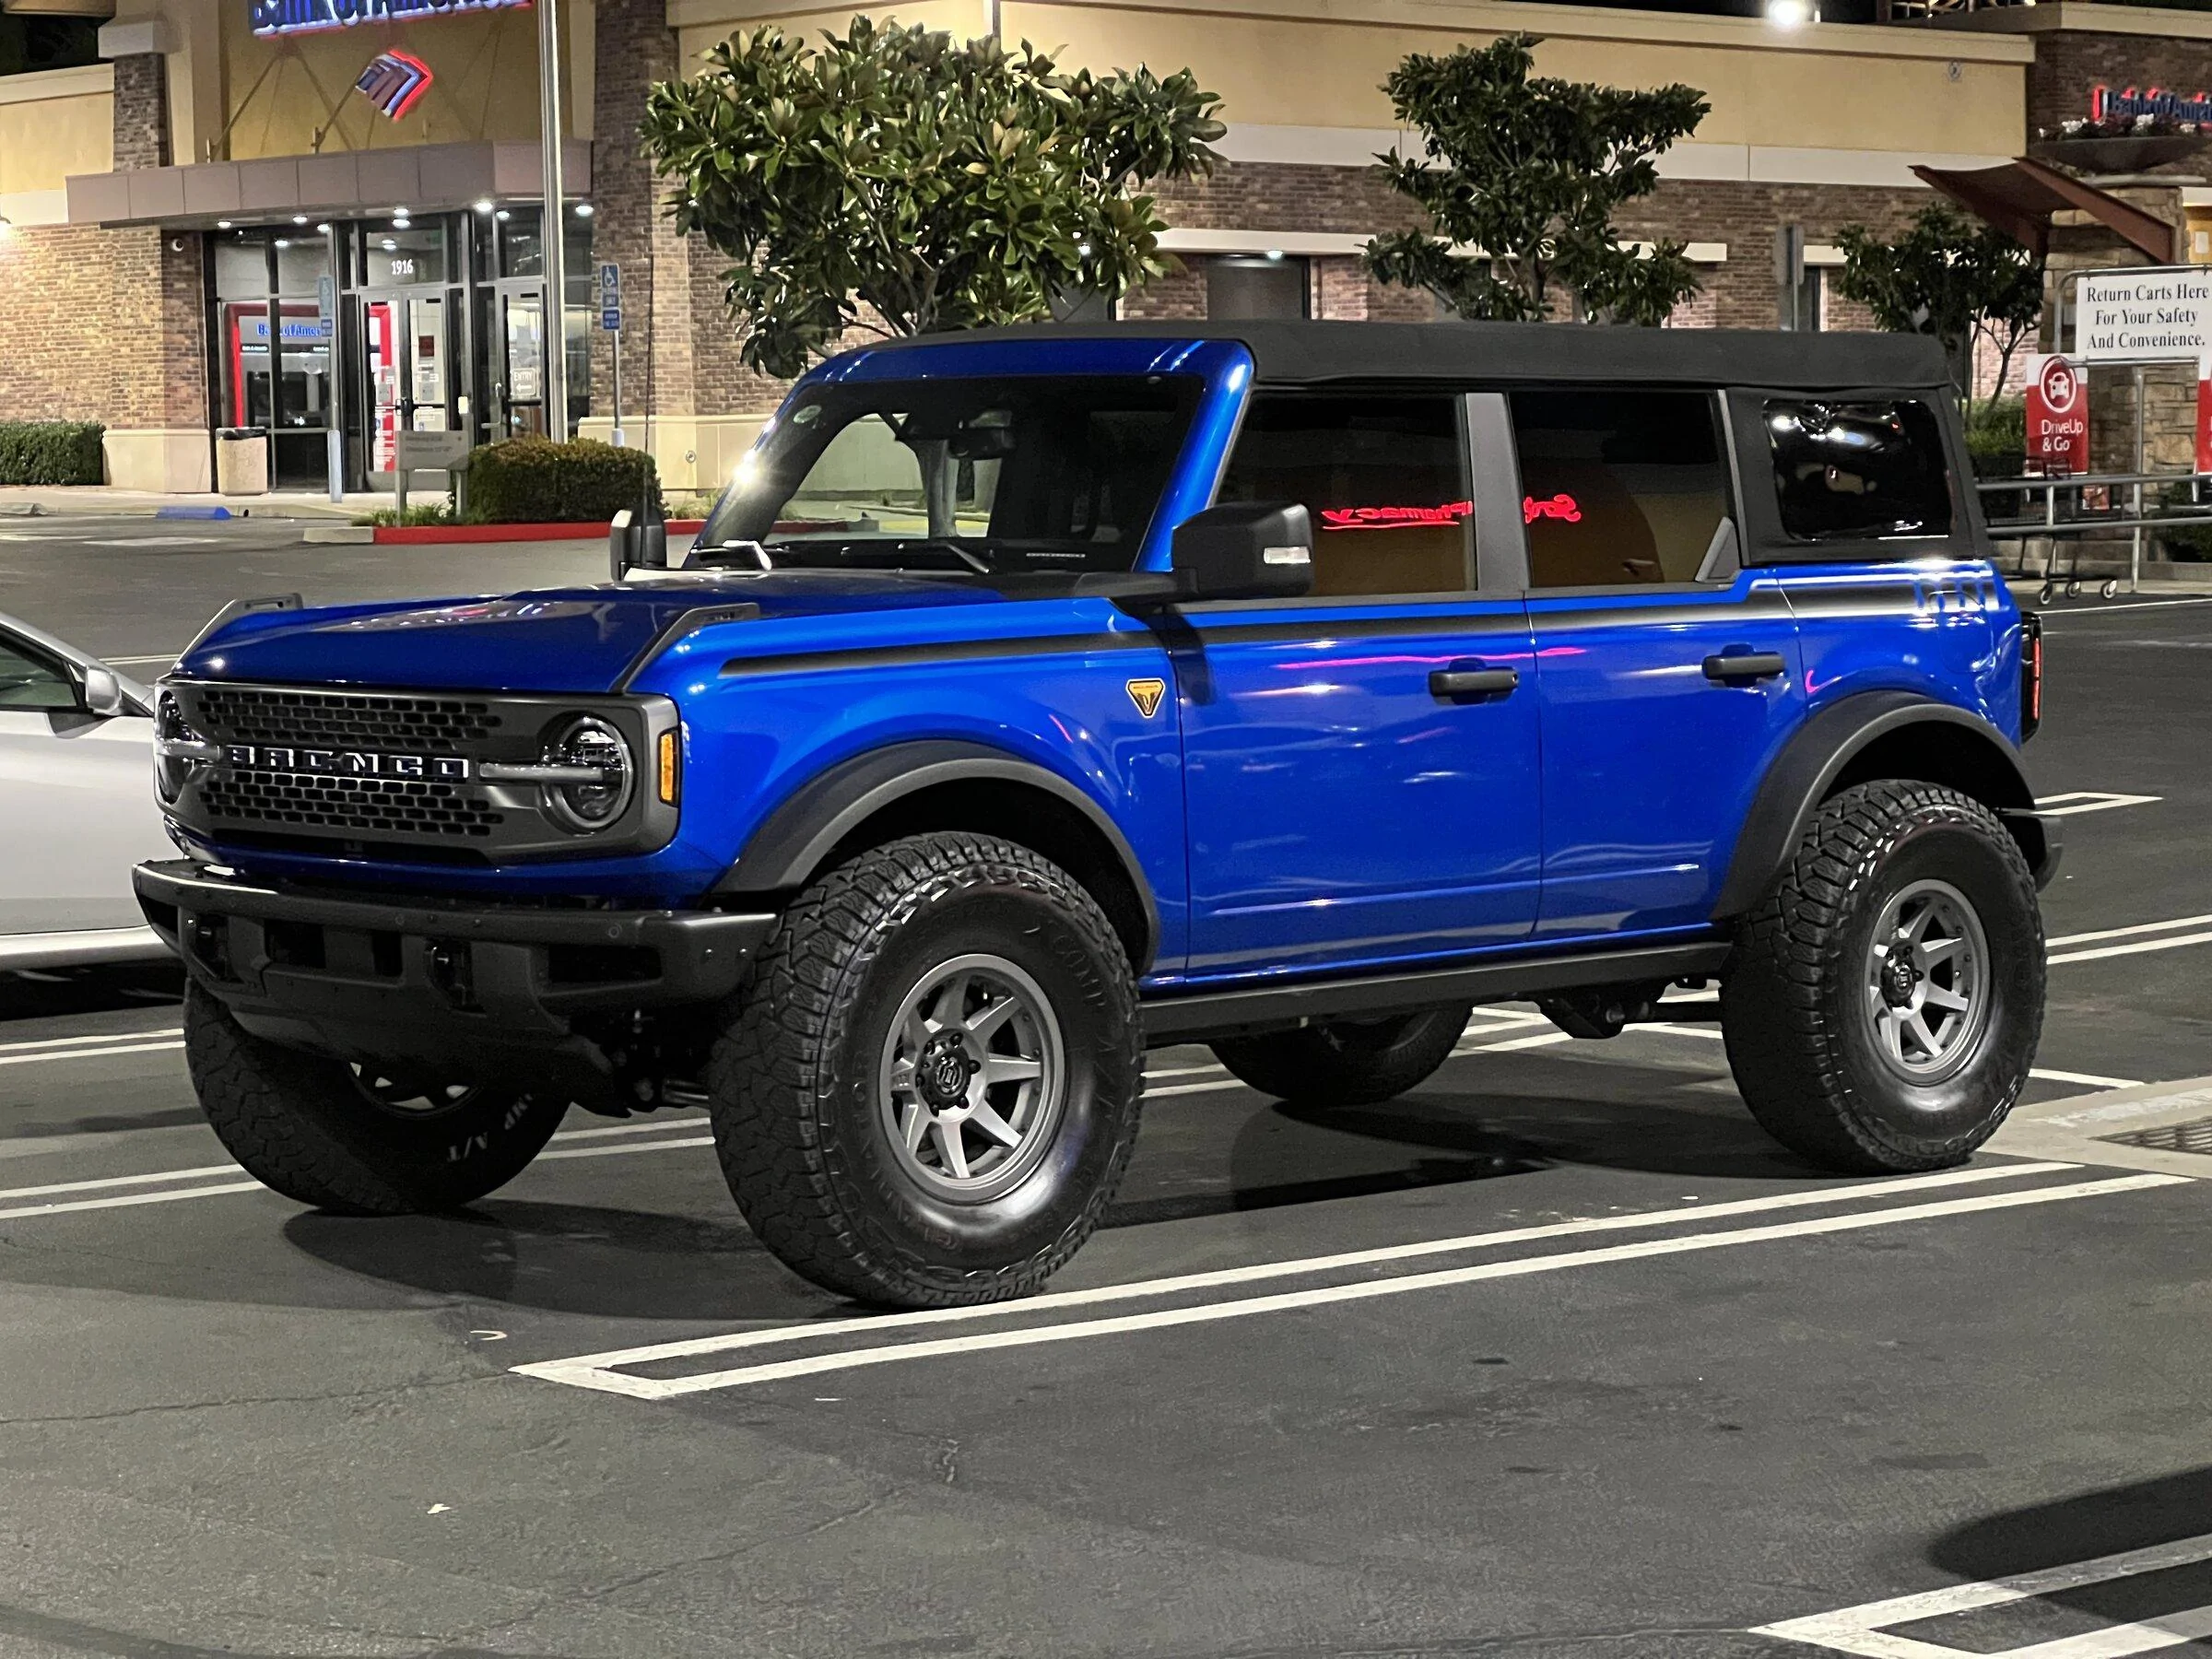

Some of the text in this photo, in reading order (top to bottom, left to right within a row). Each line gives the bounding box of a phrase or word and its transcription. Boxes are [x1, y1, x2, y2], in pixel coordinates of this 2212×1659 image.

[372, 0, 531, 20] Amer
[391, 258, 414, 275] 1916
[2087, 283, 2209, 302] Return Carts Here
[2095, 307, 2198, 327] For Your Safety
[2087, 331, 2206, 349] And Convenience.
[513, 371, 533, 382] ENTRY
[2041, 418, 2083, 436] DriveUp
[2042, 435, 2070, 452] & Go
[226, 744, 468, 779] BRONCO
